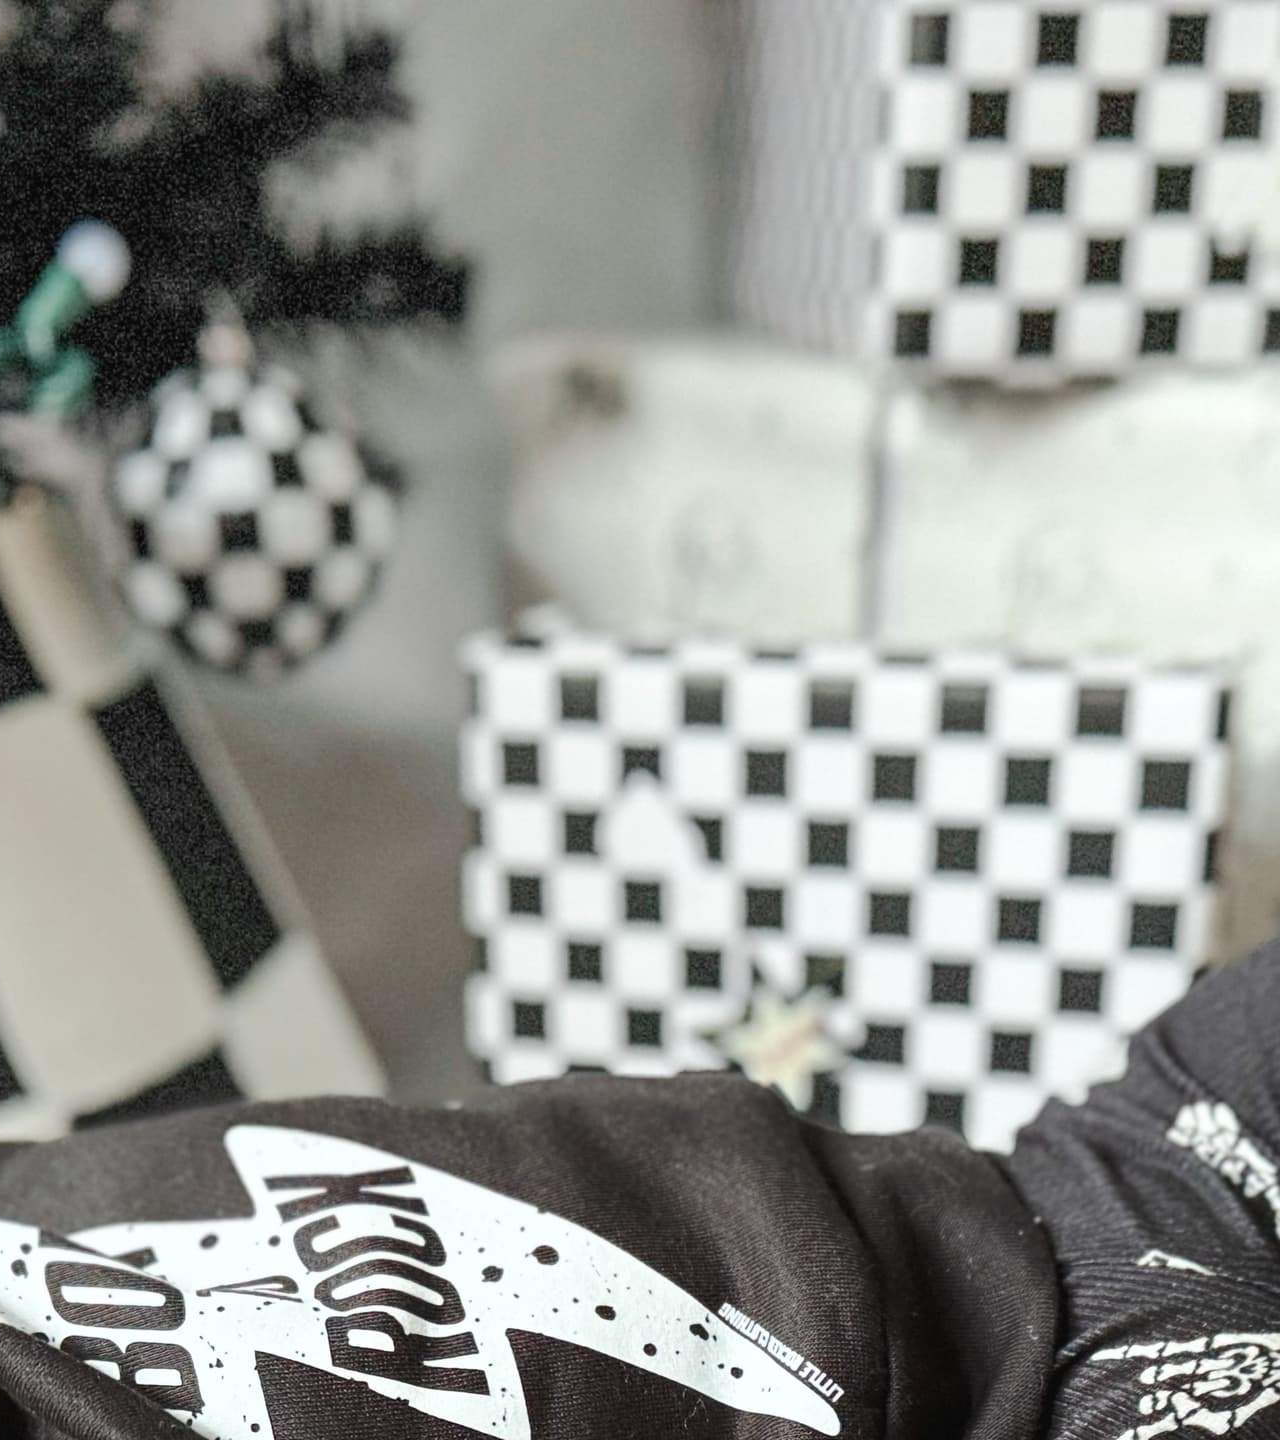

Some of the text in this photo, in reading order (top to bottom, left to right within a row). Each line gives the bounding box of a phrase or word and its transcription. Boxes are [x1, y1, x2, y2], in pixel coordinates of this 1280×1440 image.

[263, 1166, 490, 1396] ROCK
[718, 1302, 771, 1348] CLOTHING
[798, 1361, 845, 1403] LITTLE
